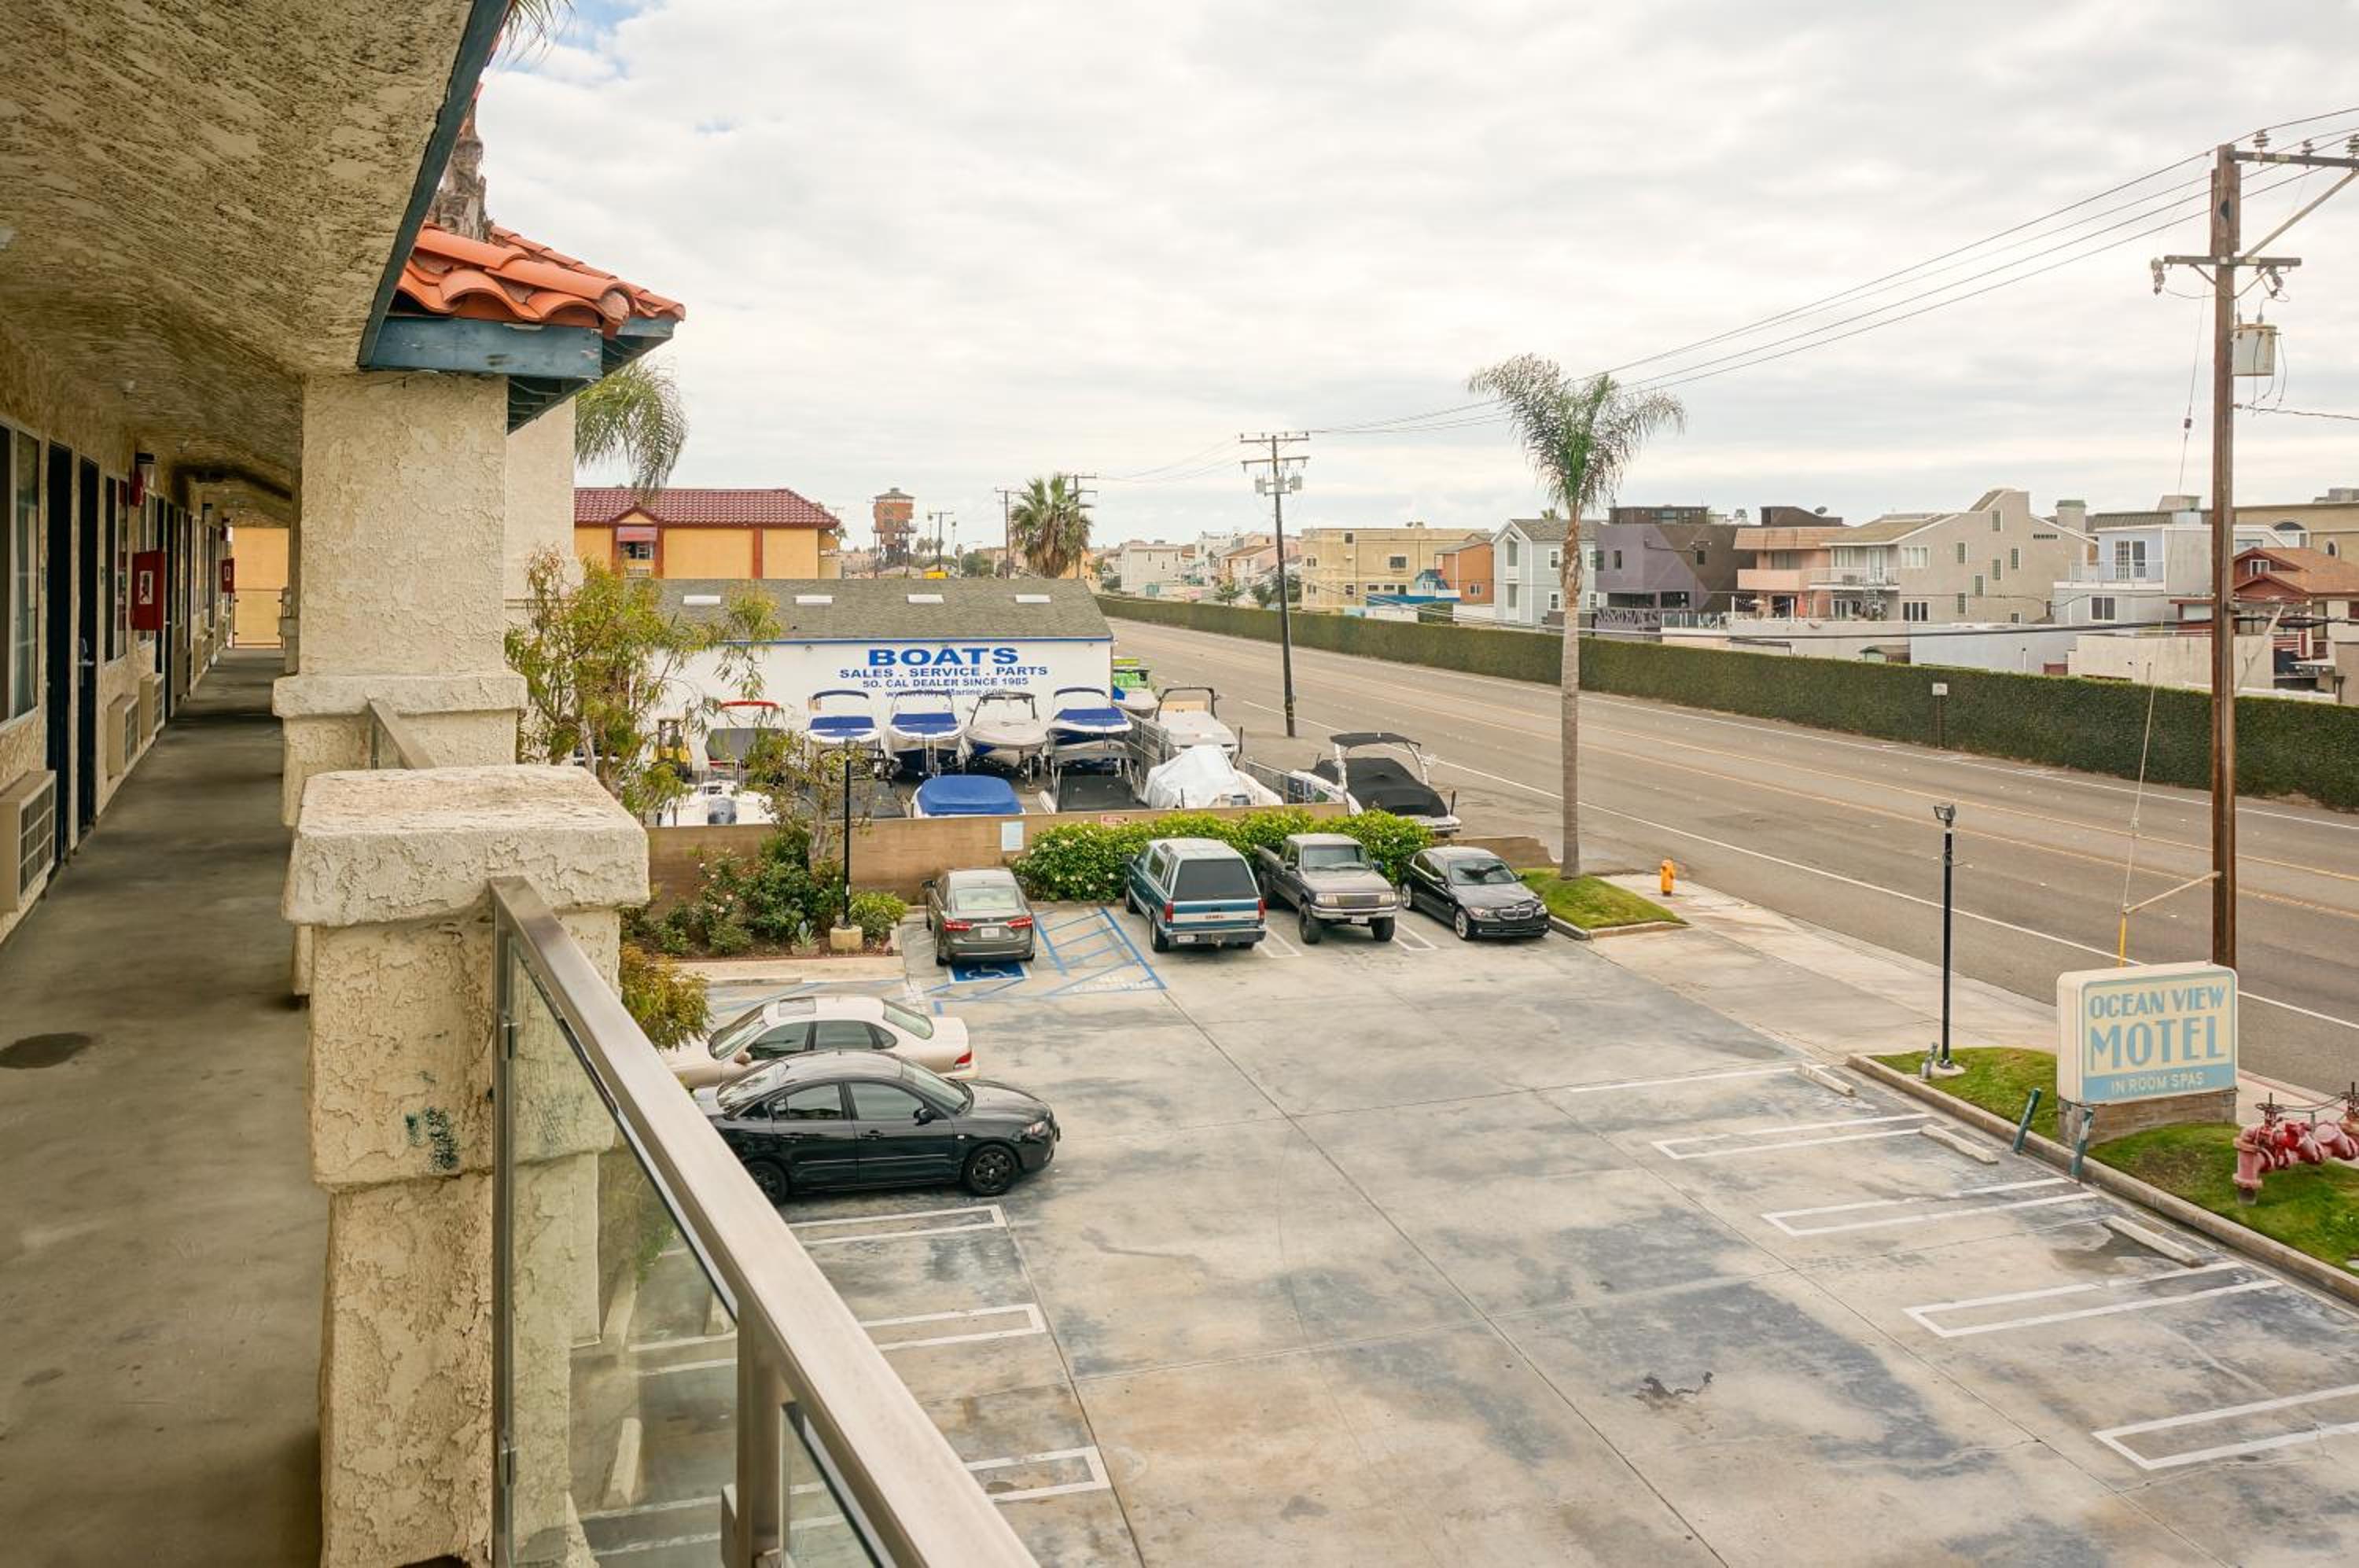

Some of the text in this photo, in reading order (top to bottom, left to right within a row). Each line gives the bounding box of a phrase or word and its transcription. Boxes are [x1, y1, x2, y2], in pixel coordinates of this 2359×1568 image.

[868, 647, 1019, 666] BOATS
[839, 666, 1048, 679] SALES SERVICE PARTS
[863, 677, 1029, 688] SO. CAL DEALER SINCE 1985
[2089, 985, 2226, 1020] OCEAN VIEW
[2090, 1015, 2227, 1071] MOTEL
[2111, 1071, 2204, 1095] IN ROOM SPAS
